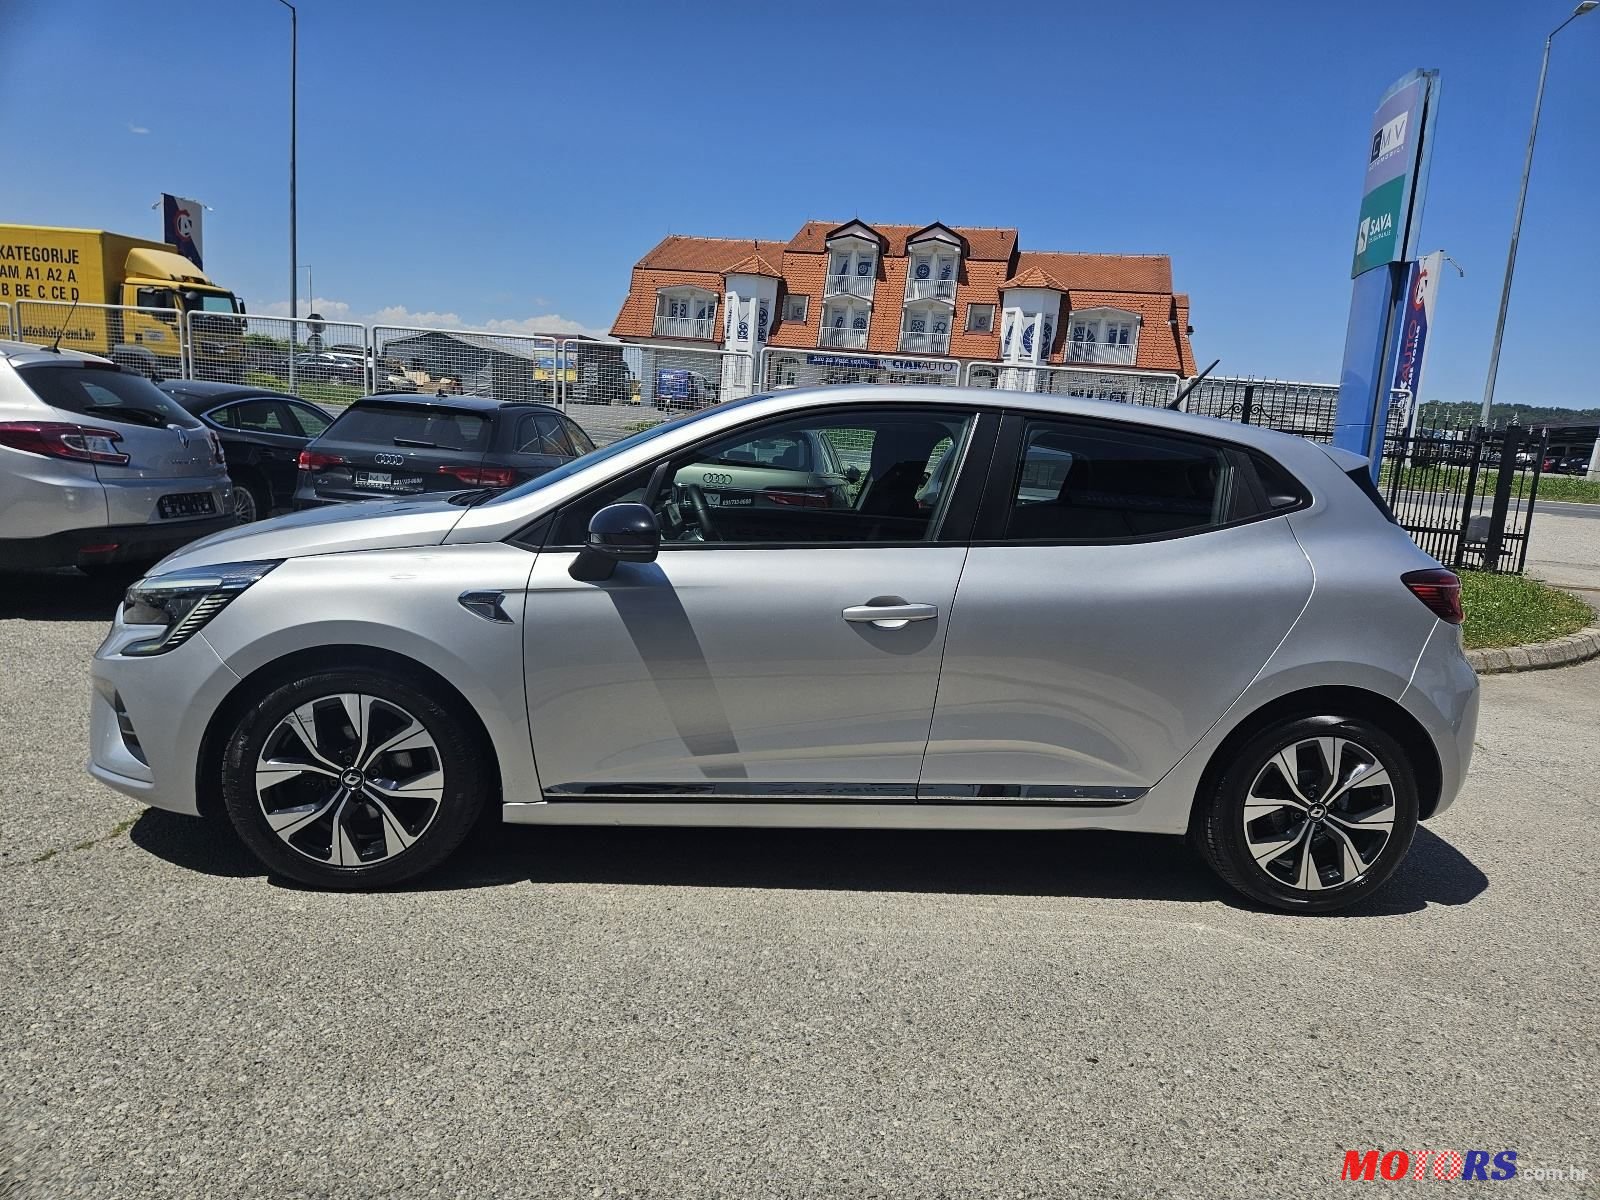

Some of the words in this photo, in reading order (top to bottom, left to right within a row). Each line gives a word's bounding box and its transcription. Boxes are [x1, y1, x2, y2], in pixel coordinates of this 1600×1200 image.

[1369, 212, 1392, 236] SAVA
[0, 245, 79, 264] KATEGORIJE
[71, 287, 79, 301] D
